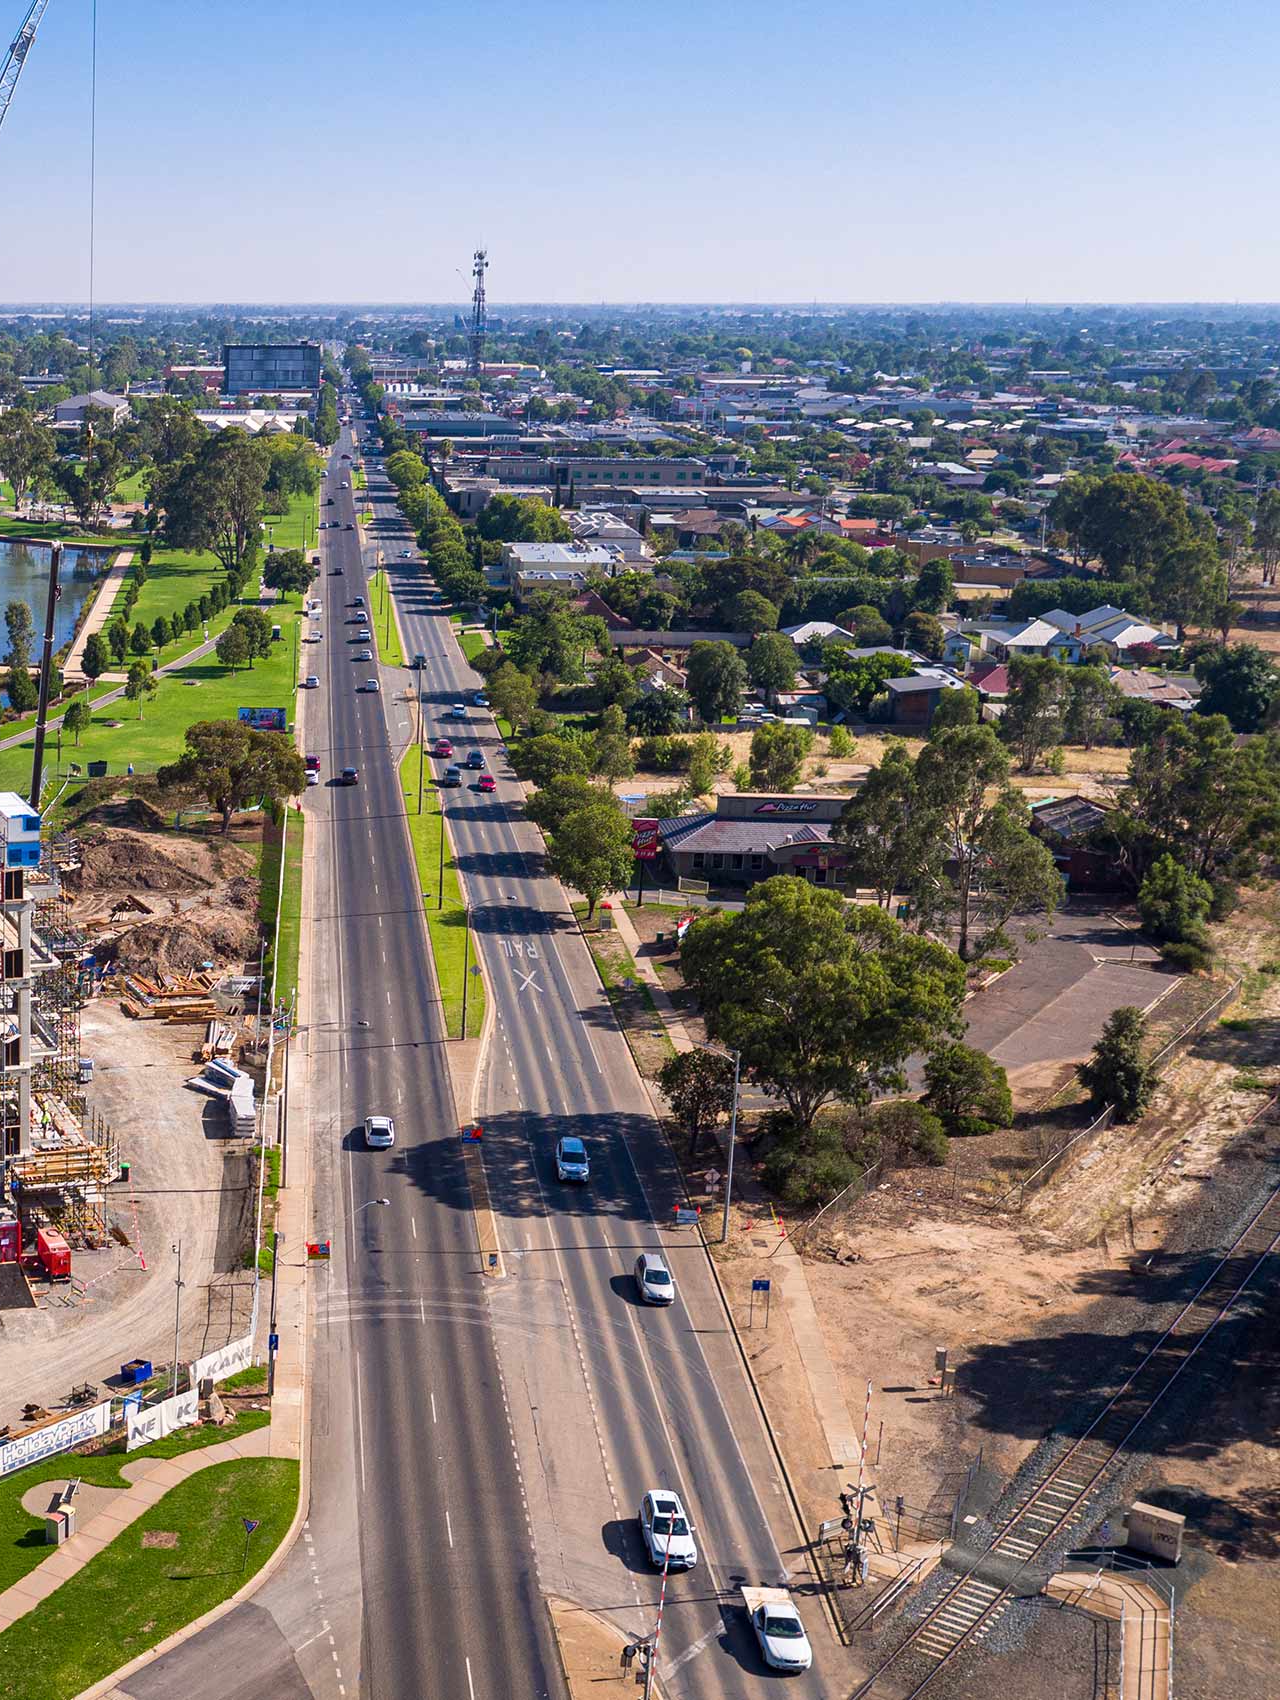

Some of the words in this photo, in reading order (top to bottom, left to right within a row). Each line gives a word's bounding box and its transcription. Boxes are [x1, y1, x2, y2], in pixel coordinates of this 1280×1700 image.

[776, 802, 799, 811] Pizza
[800, 802, 817, 811] Hut
[498, 940, 539, 959] RAIL
[207, 1345, 252, 1377] KANE
